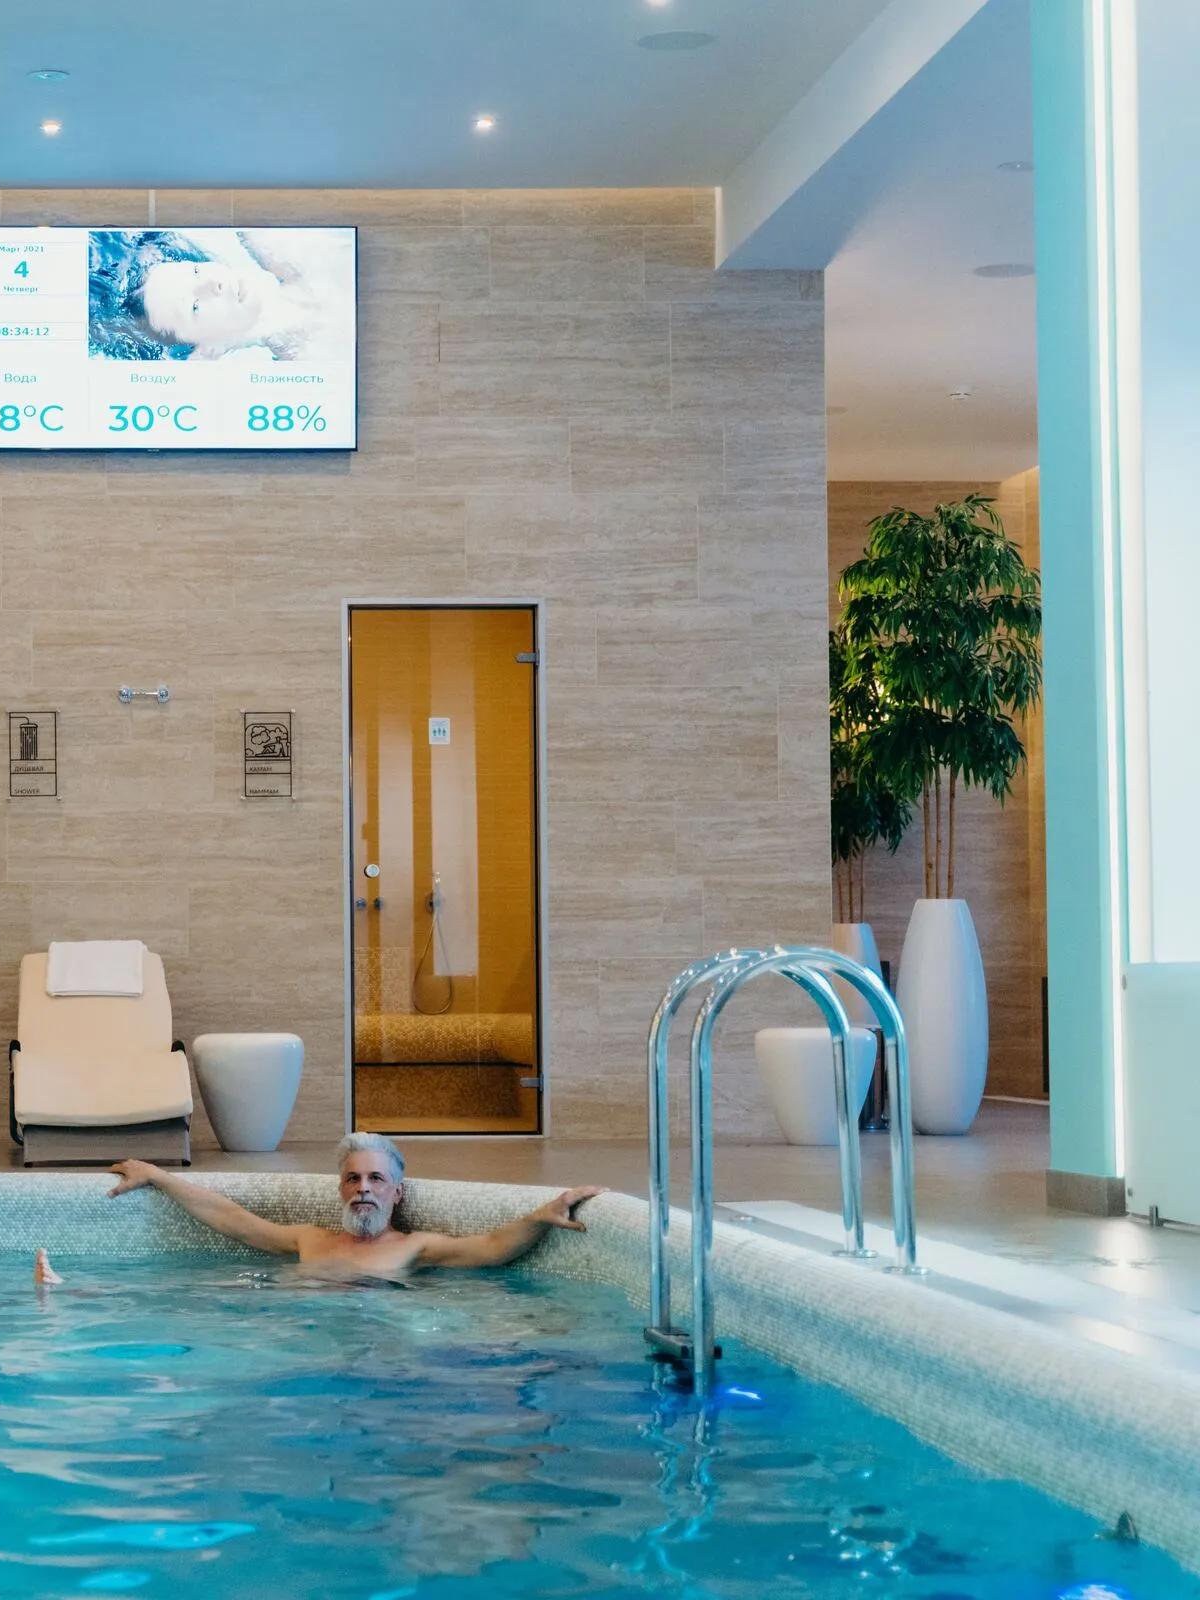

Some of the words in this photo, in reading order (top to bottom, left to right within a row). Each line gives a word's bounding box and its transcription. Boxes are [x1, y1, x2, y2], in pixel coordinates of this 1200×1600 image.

[23, 245, 44, 253] 2021
[13, 260, 30, 278] 4
[3, 373, 37, 384] Вода
[130, 373, 177, 385] Воздух
[249, 373, 324, 384] Влажность
[108, 404, 198, 432] 30°C
[247, 404, 327, 432] 88%
